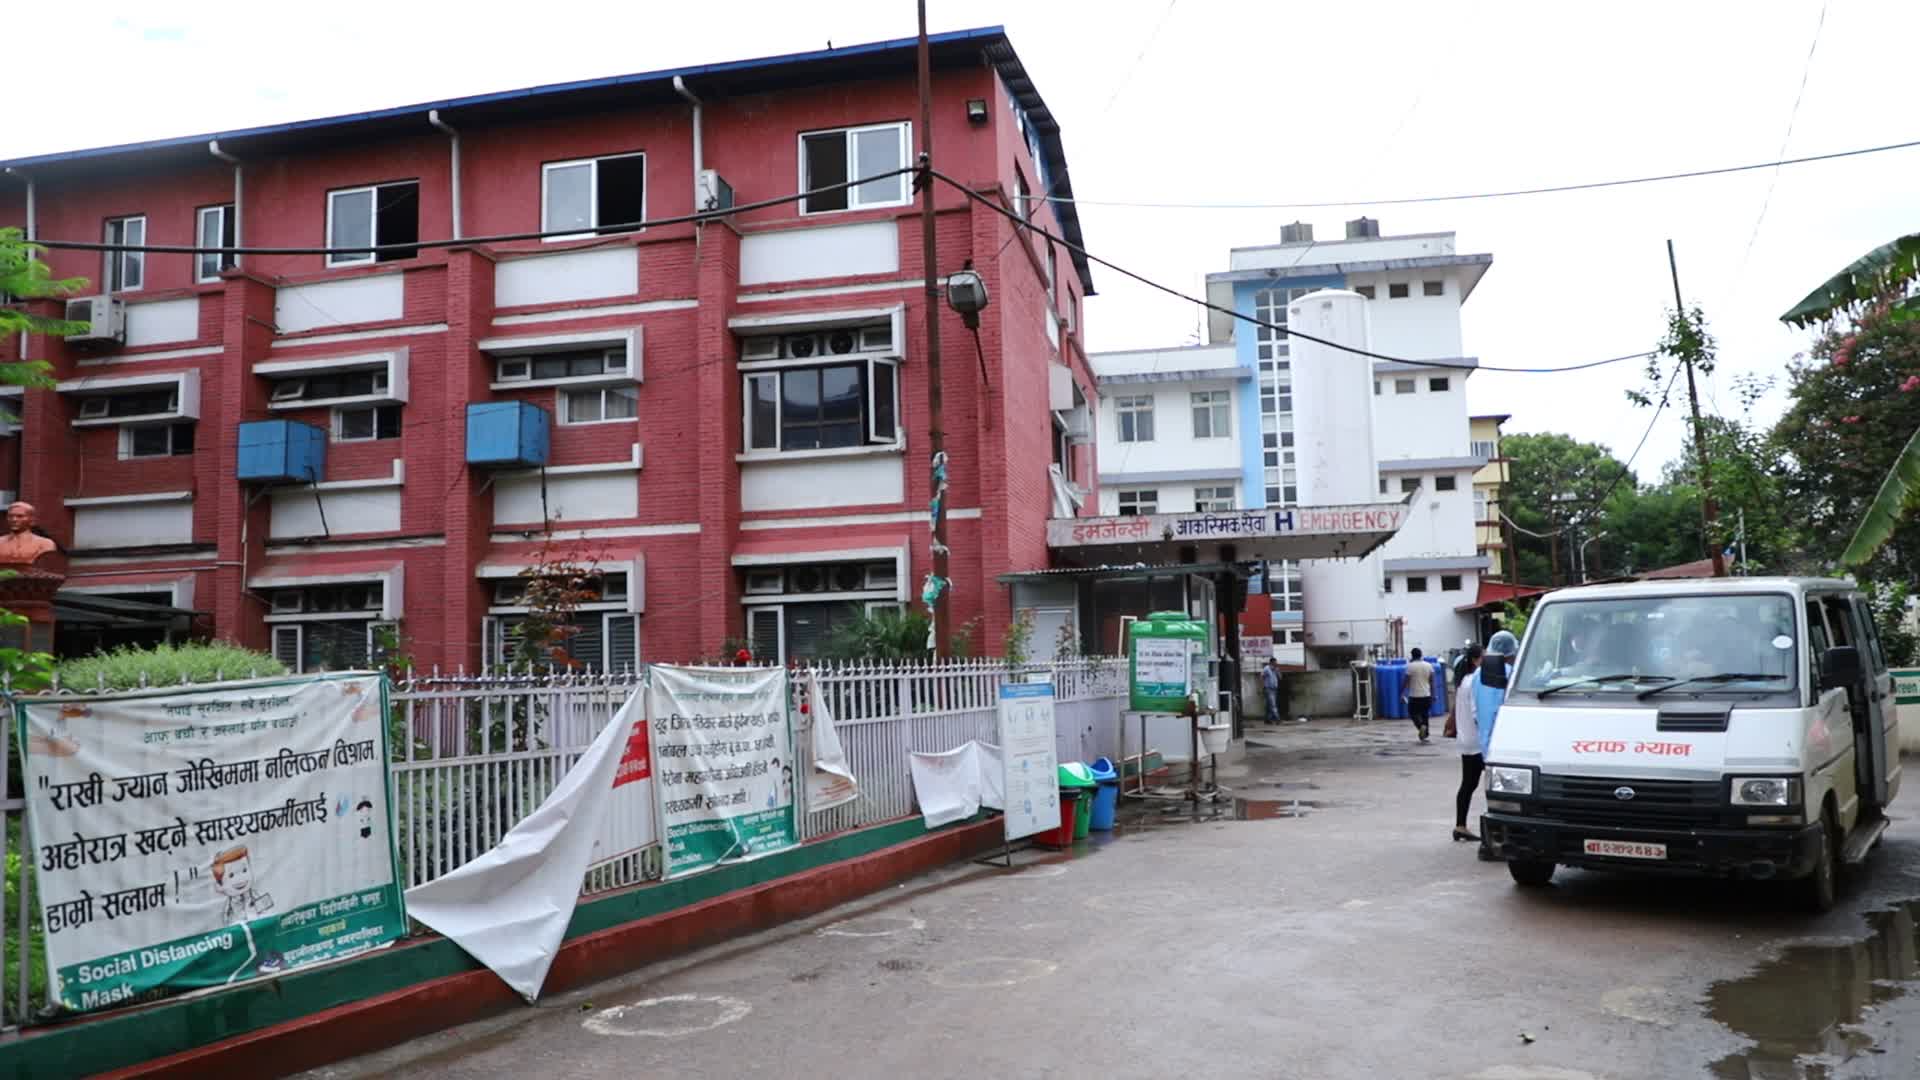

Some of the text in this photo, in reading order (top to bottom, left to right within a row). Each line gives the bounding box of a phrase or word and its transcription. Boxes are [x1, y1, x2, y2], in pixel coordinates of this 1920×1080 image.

[1072, 519, 1149, 544] इमर्जेन्सी
[1275, 511, 1294, 532] H
[1300, 511, 1400, 531] EMERGENCY
[1571, 740, 1627, 753] स्टाफ
[112, 772, 168, 802] ज्यान
[176, 758, 259, 793] जोखिममा
[265, 747, 331, 779] नलिकन
[41, 831, 128, 872] अहोरात्र
[135, 816, 187, 856] खट्ने
[47, 889, 95, 934] हाम्रो
[101, 883, 167, 920] सलाम
[79, 955, 137, 984] Social
[141, 933, 233, 968] Distancing
[81, 983, 135, 1009] Mask
